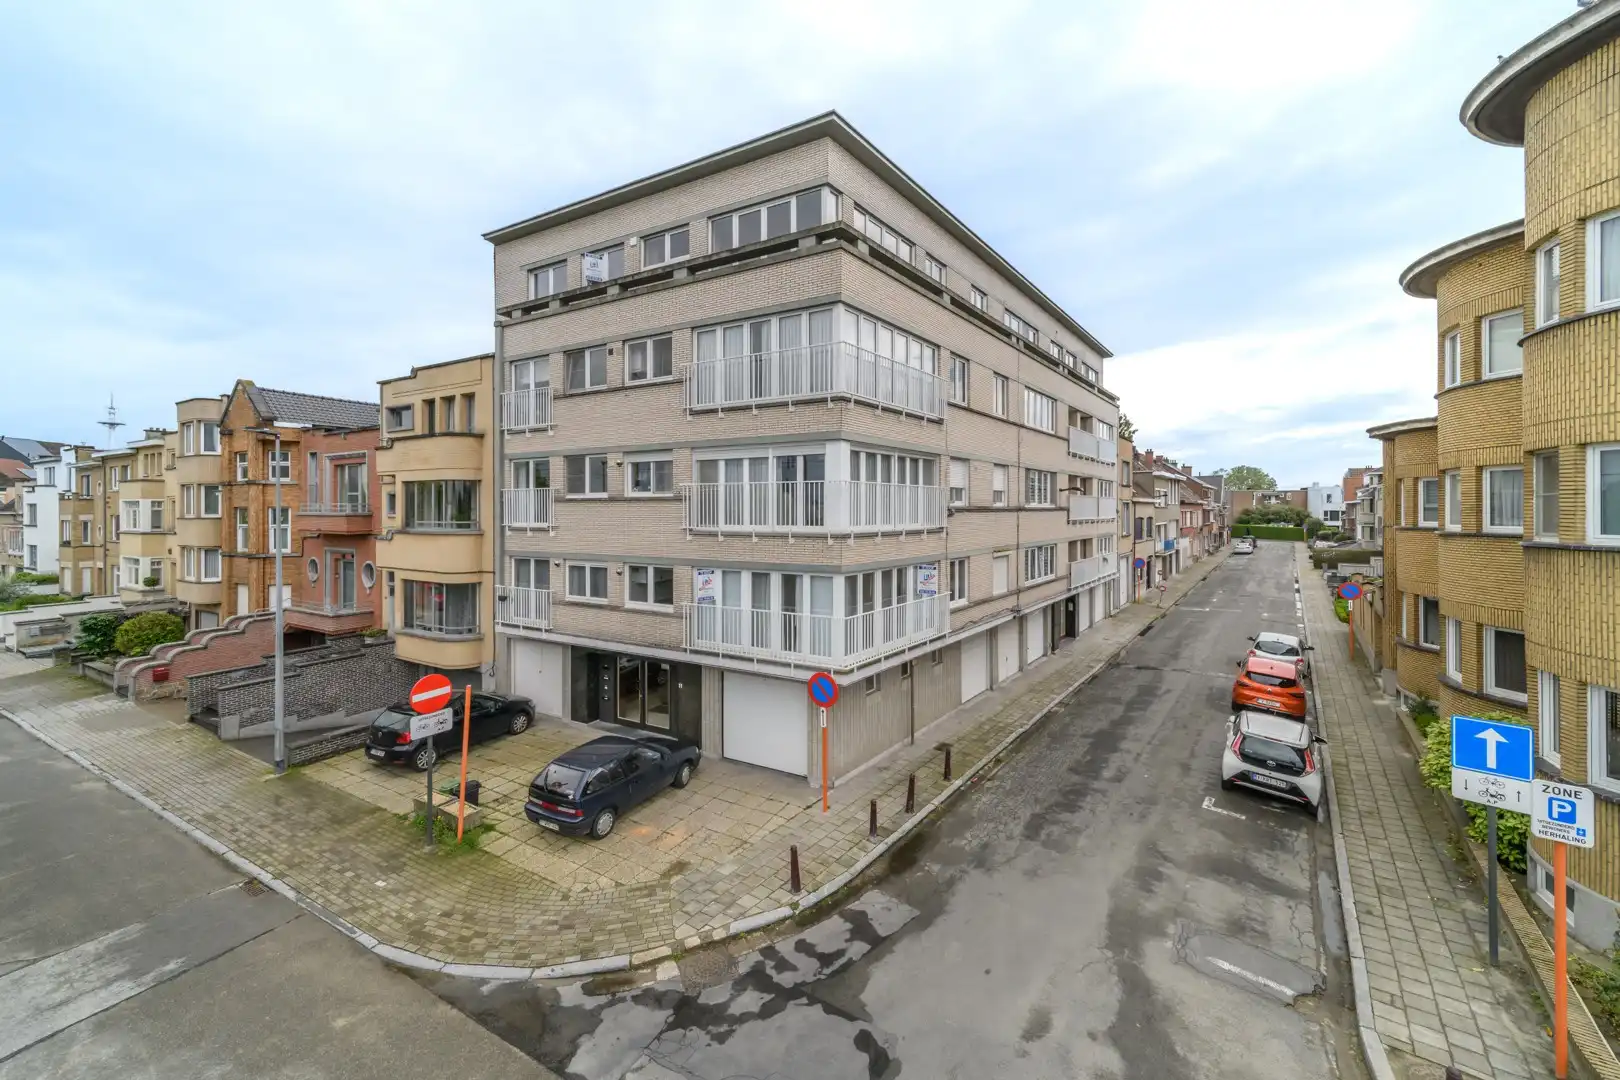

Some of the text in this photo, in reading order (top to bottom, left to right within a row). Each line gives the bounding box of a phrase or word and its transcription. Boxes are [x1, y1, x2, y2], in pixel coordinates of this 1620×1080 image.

[1542, 784, 1582, 800] ZONE
[1552, 800, 1572, 818] P
[1538, 830, 1586, 844] HERHALING
